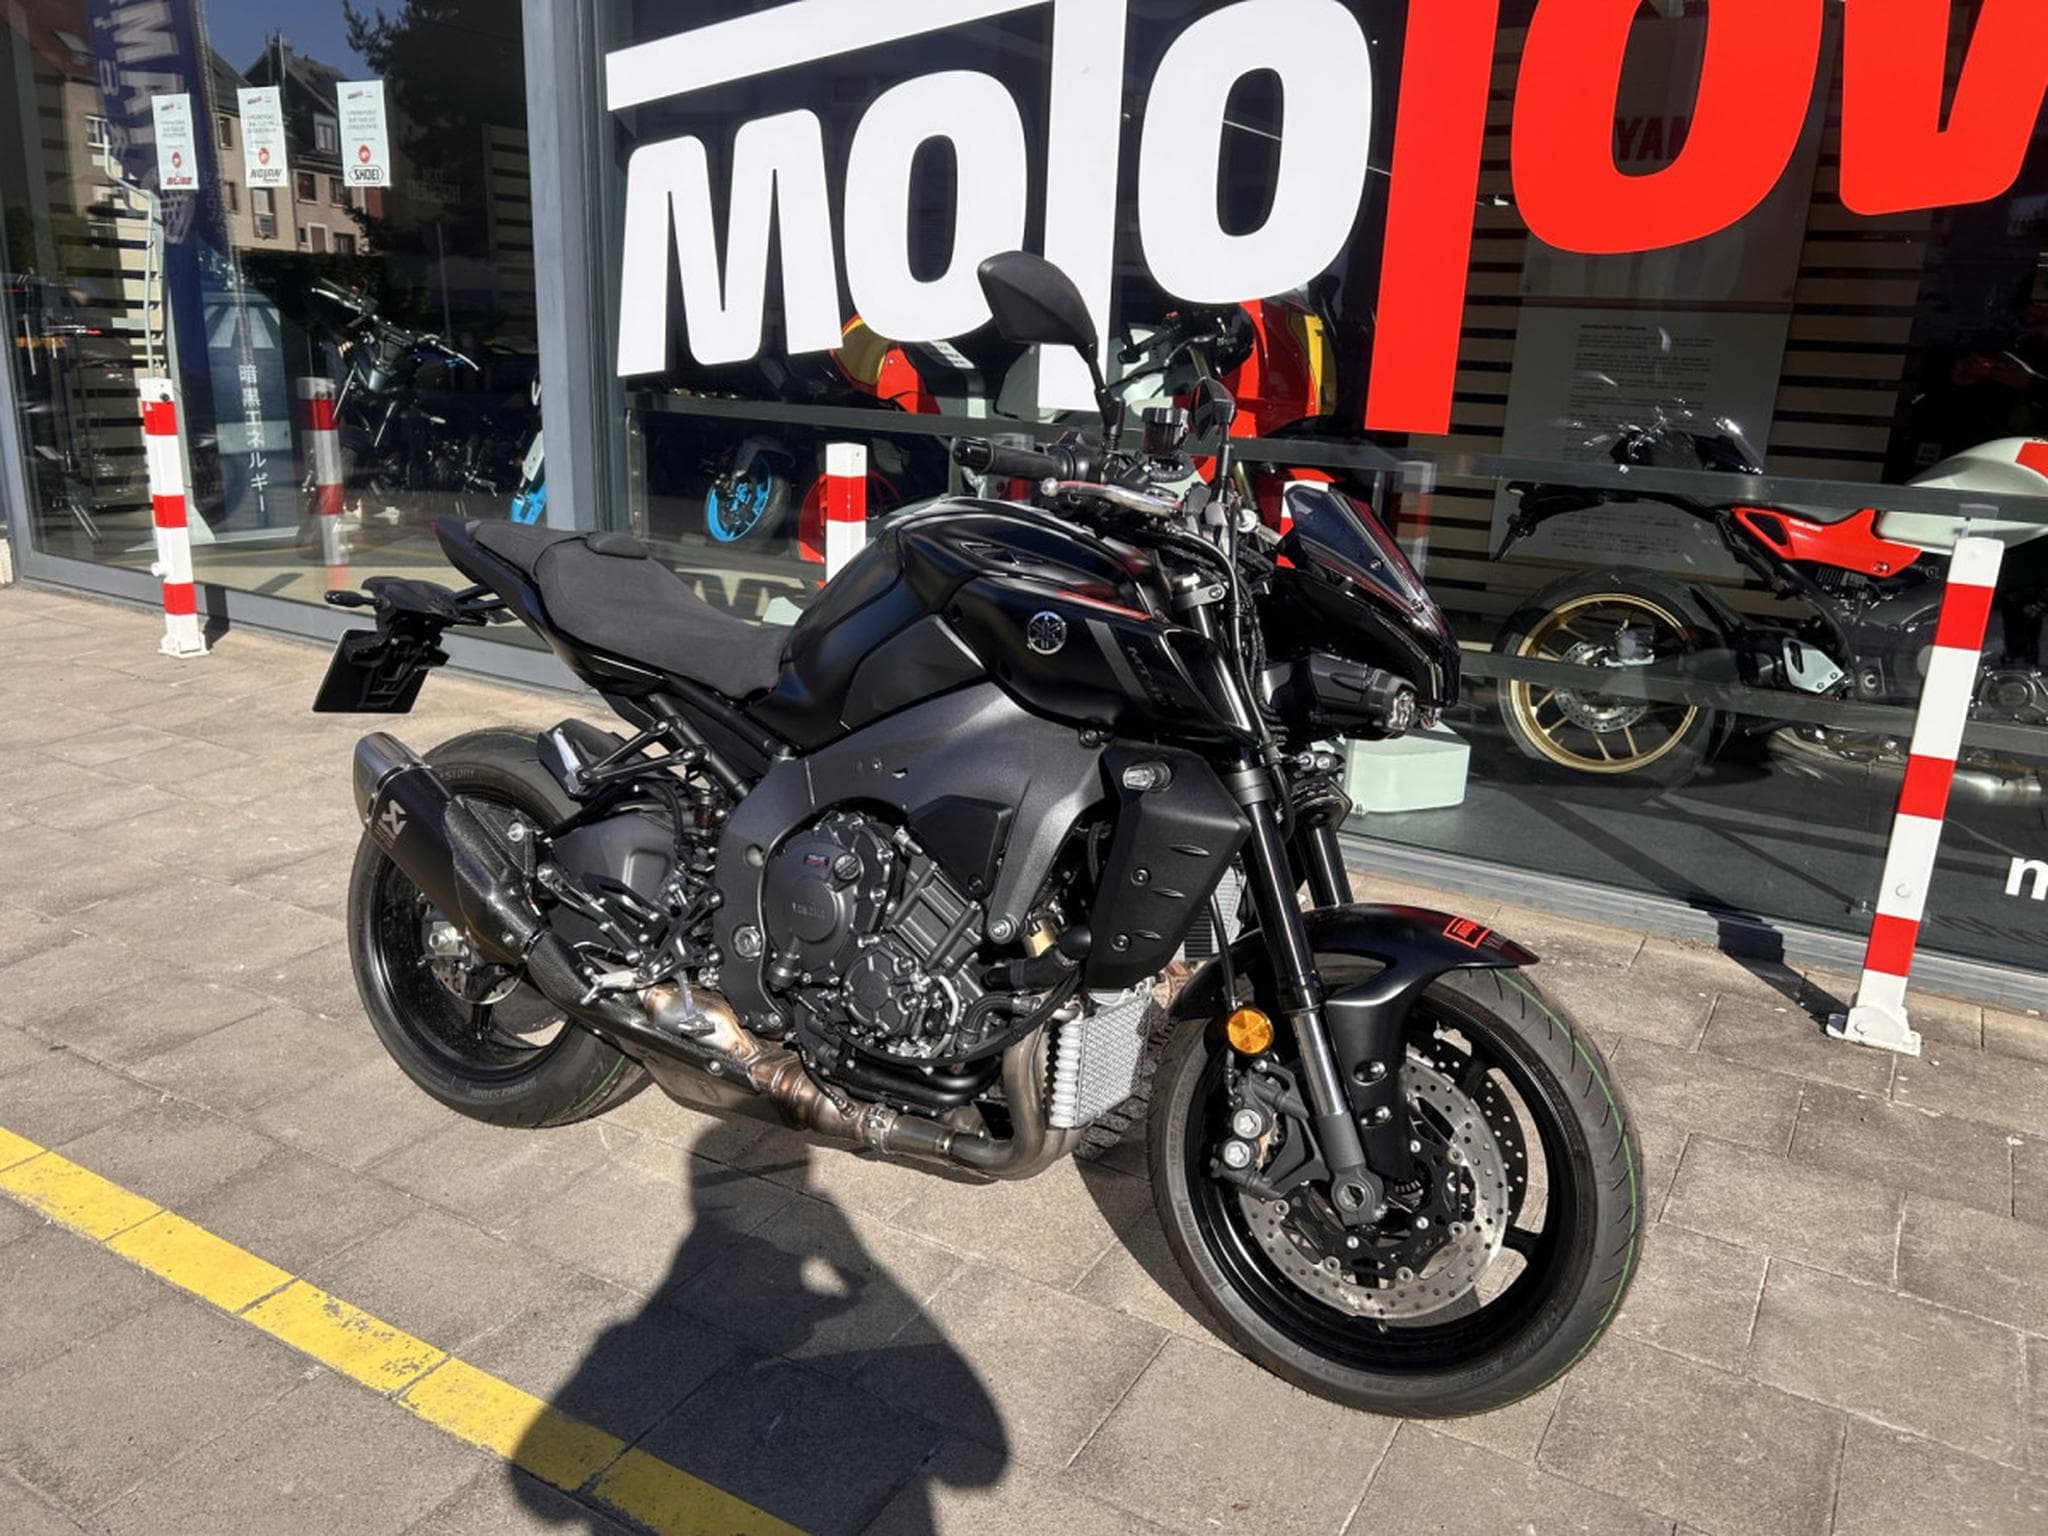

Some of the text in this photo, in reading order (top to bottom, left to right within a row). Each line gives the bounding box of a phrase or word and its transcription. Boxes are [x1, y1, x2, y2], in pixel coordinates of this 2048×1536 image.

[238, 364, 269, 513] 暗黒エネルギー
